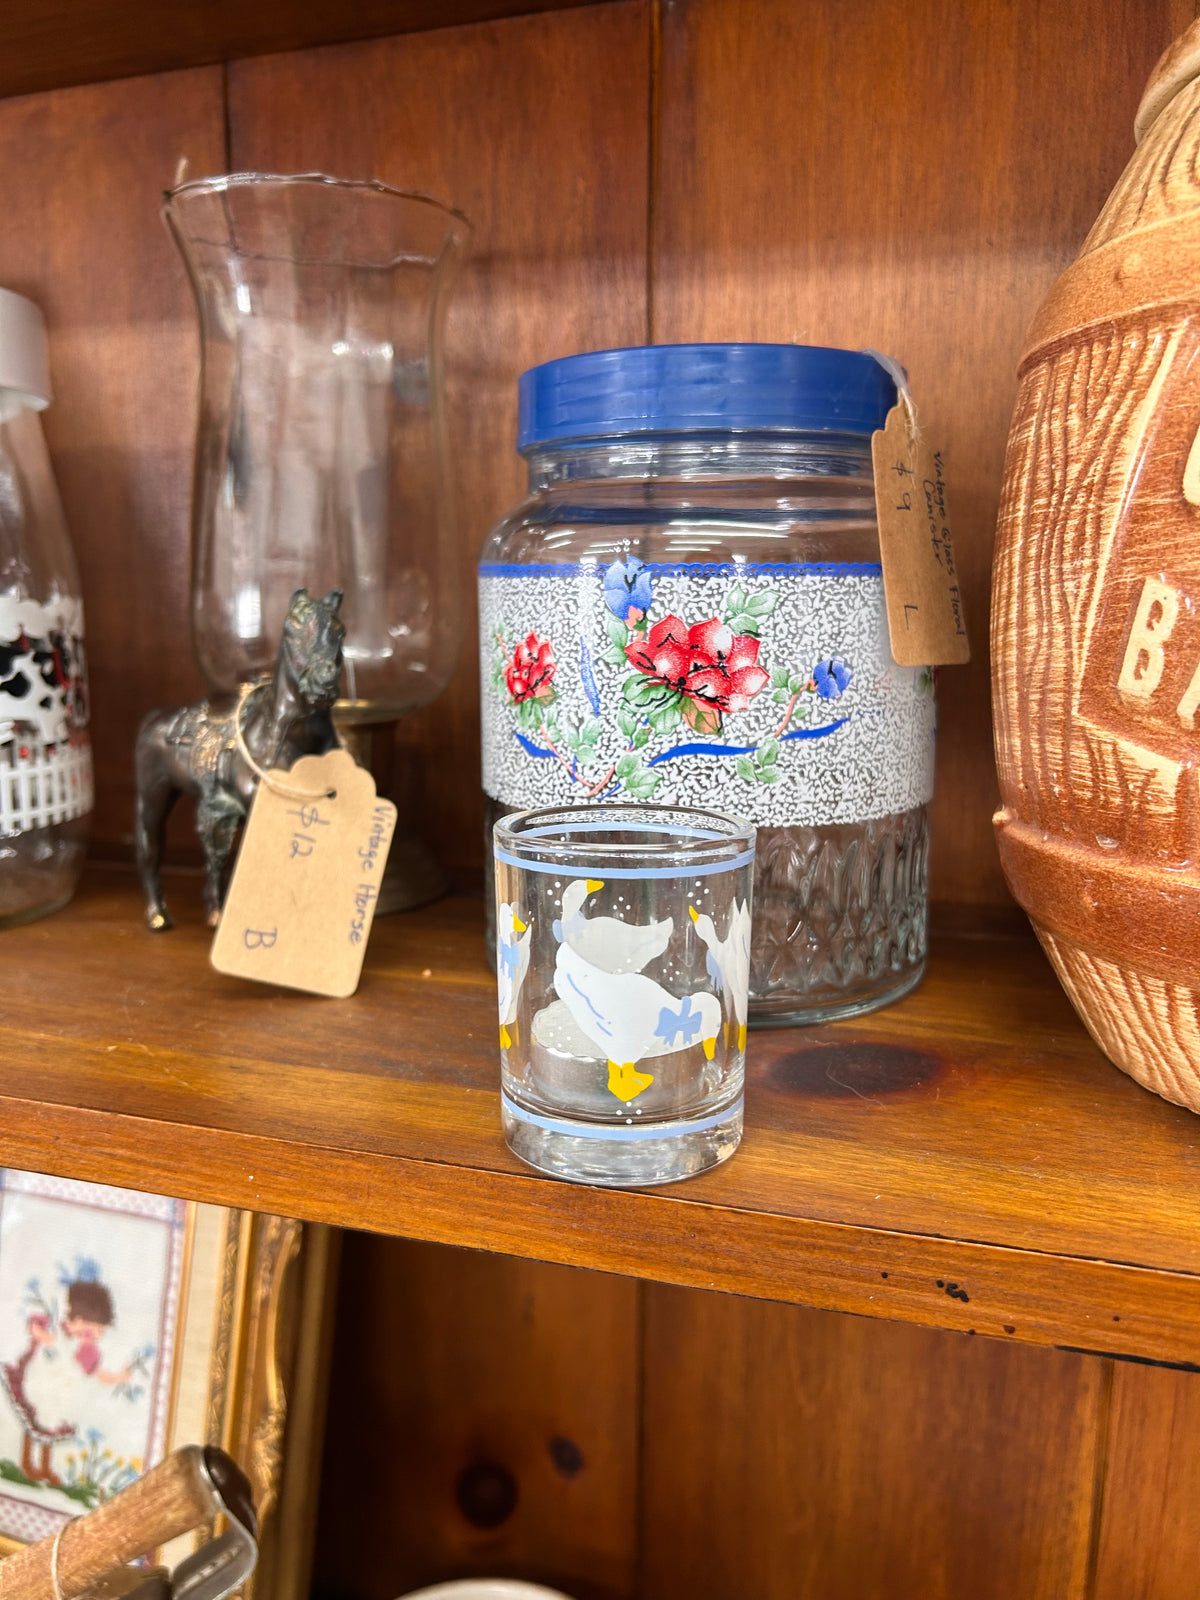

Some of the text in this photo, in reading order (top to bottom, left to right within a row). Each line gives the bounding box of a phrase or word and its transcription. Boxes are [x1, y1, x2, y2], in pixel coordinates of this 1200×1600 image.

[903, 604, 919, 630] L
[286, 804, 330, 860] $12
[349, 805, 393, 945] Vintage Horse
[243, 926, 278, 951] B
